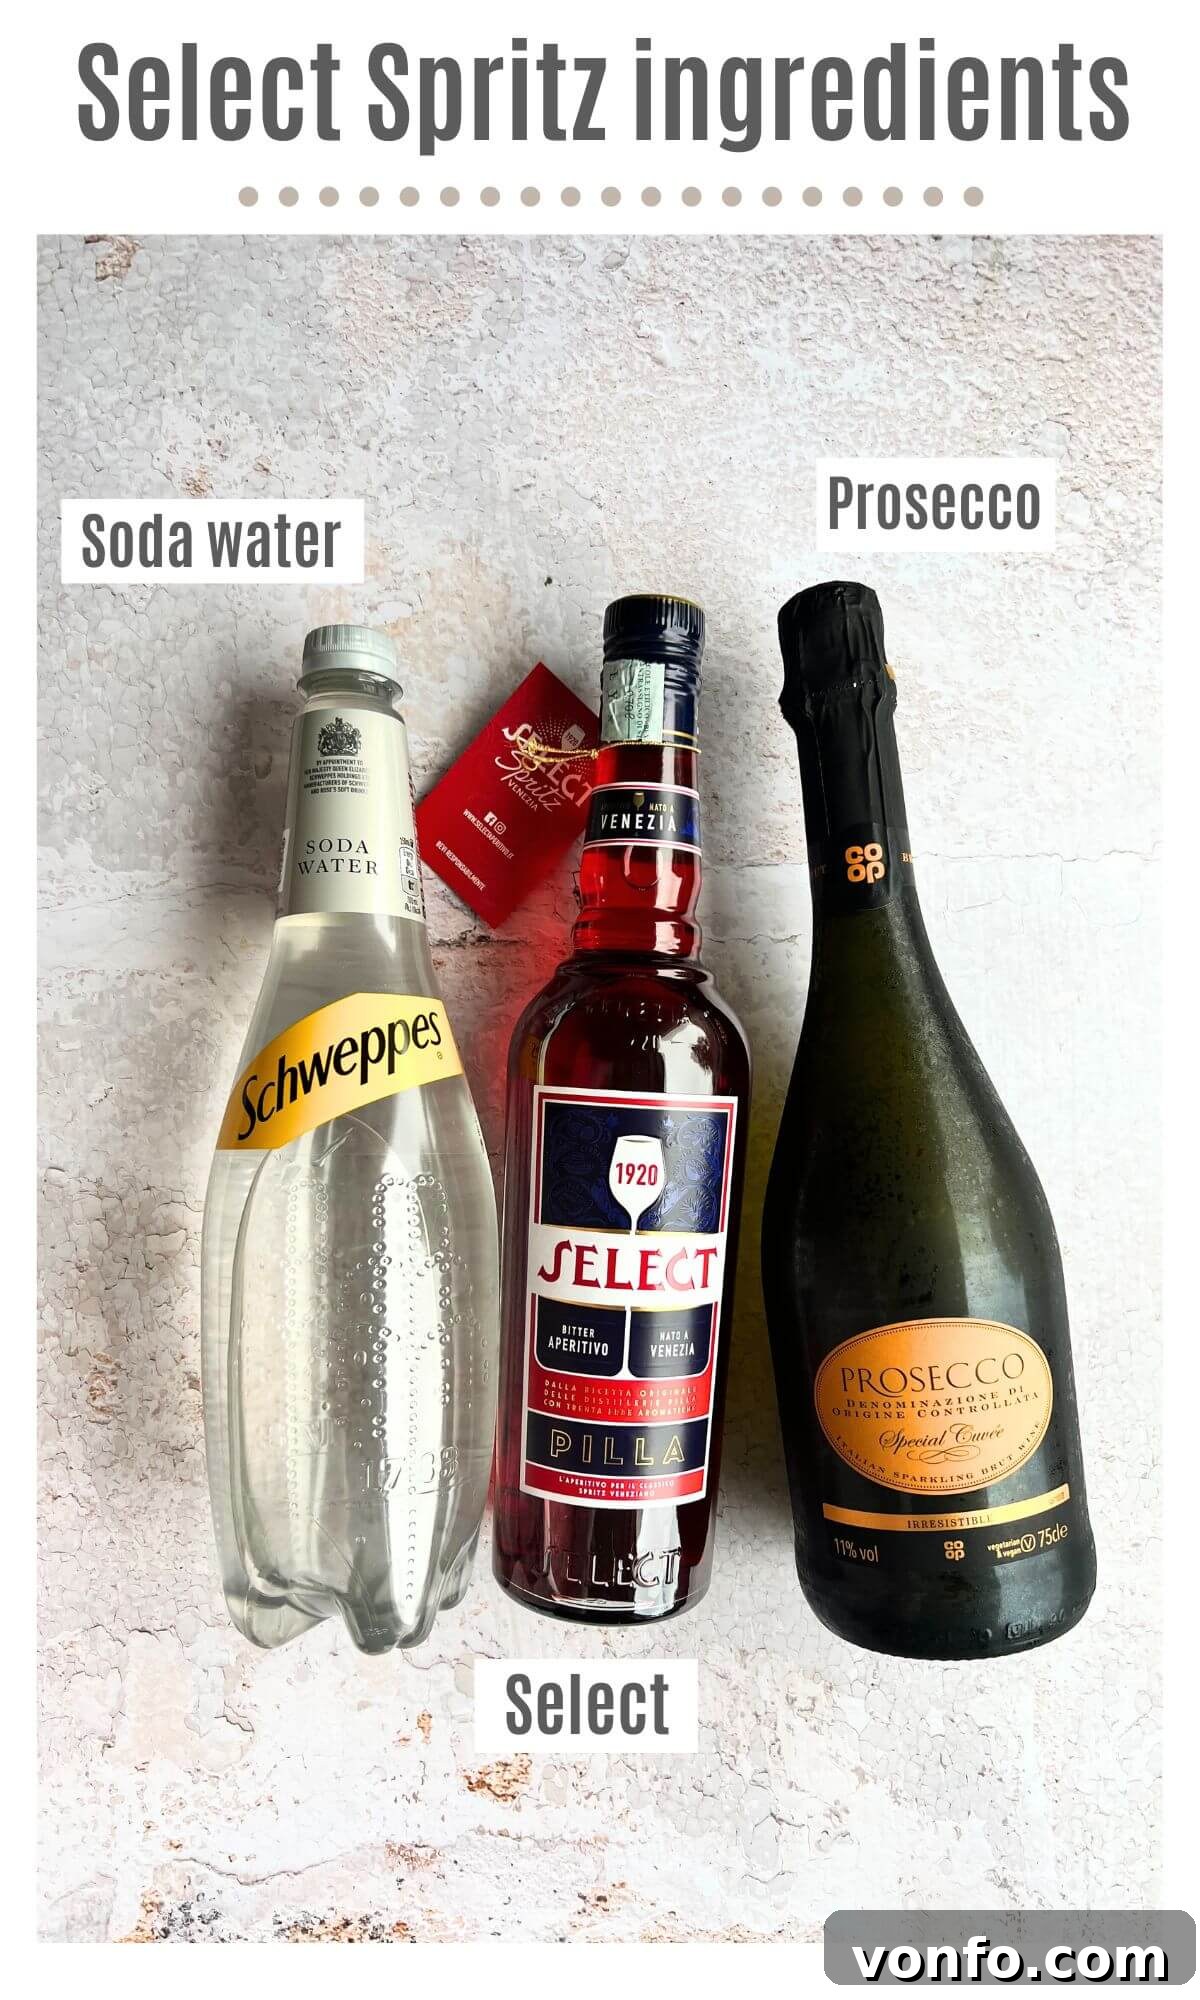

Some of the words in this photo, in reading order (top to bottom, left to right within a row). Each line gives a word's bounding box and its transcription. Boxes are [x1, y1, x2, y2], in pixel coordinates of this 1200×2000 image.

[508, 779, 538, 812] VENEZIA
[601, 813, 677, 832] VENEZIA
[306, 838, 369, 855] SODA
[297, 858, 379, 876] WATER
[237, 1011, 442, 1141] Schweppes
[615, 1162, 658, 1186] 1920
[537, 1239, 718, 1292] SELECT
[562, 1324, 595, 1338] BITTER
[659, 1331, 681, 1342] NATO
[684, 1330, 689, 1340] A
[547, 1336, 609, 1356] APERITIVO
[650, 1343, 695, 1358] VENEZIA
[545, 1379, 577, 1391] DALLA
[841, 1353, 1025, 1398] PROSECCO
[543, 1398, 561, 1408] CON
[544, 1389, 575, 1401] DELLE
[832, 1407, 906, 1419] ORIGINE
[917, 1391, 1040, 1418] CONTROLLATA
[847, 1391, 1000, 1409] DENOMINAZIONE
[1008, 1385, 1025, 1396] DI
[550, 1429, 685, 1466] PILLA
[836, 1435, 887, 1474] ITALIAN
[893, 1470, 975, 1484] SPARKLING
[980, 1454, 1014, 1475] BRUT
[1018, 1421, 1040, 1451] WINE
[878, 1428, 947, 1455] Special
[833, 1537, 858, 1558] 11%
[859, 1545, 880, 1563] vol
